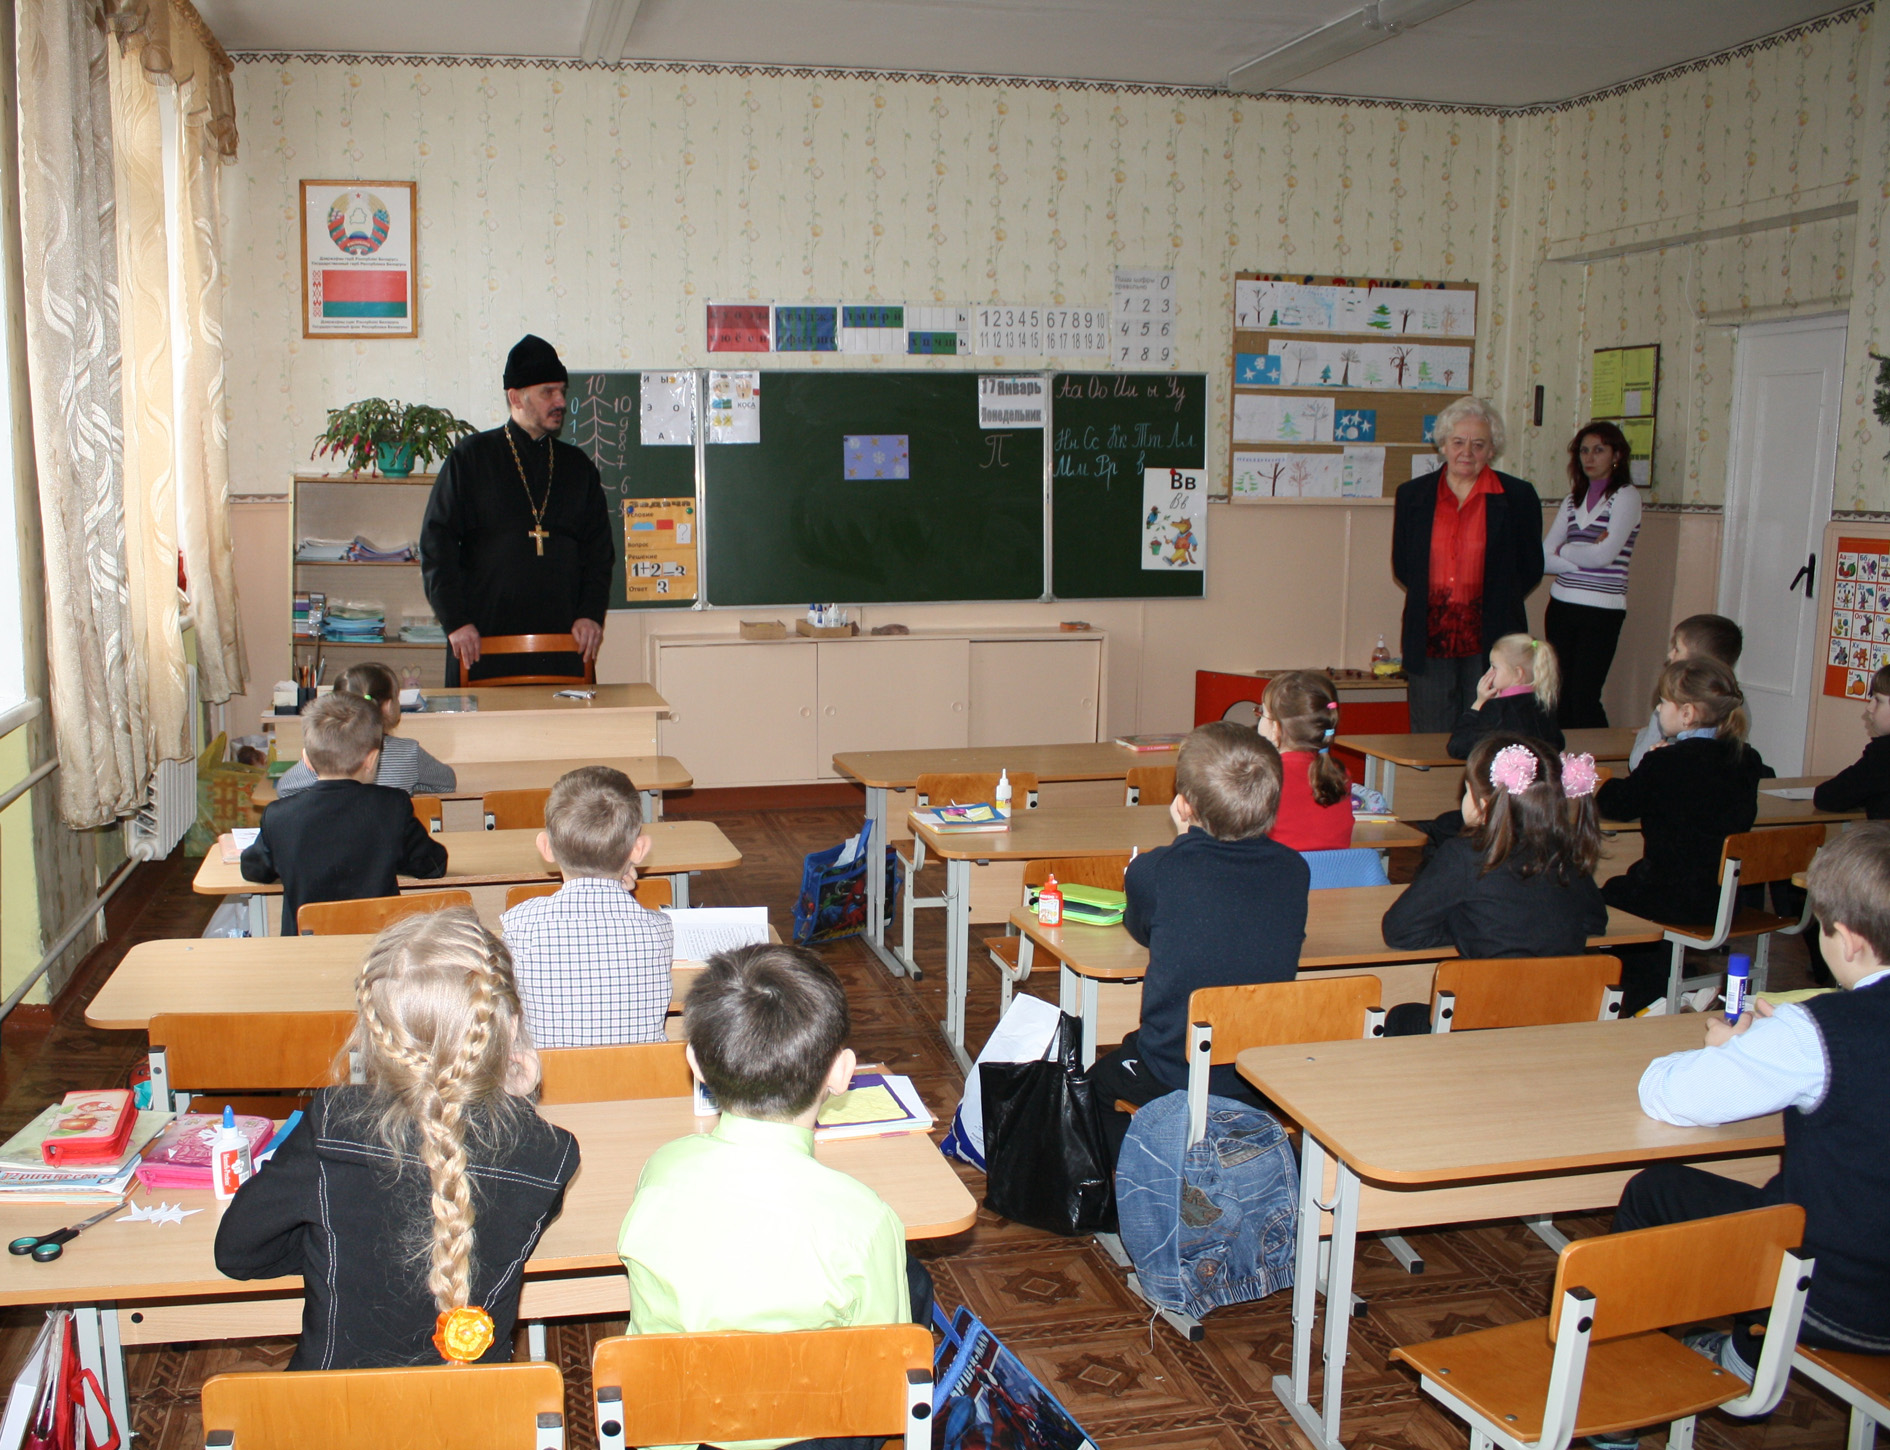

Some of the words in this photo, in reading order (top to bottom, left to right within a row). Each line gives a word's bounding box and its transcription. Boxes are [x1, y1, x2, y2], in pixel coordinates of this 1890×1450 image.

[1160, 275, 1170, 290] 0
[1123, 298, 1130, 312] 1
[1142, 298, 1150, 313] 2
[1161, 298, 1170, 313] 3
[980, 310, 988, 327] 1
[993, 310, 1001, 327] 2
[1006, 310, 1014, 327] 3
[1018, 311, 1026, 327] 4
[1030, 310, 1039, 327] 5
[1046, 312, 1055, 328] 6
[1059, 312, 1067, 328] 7
[1072, 312, 1080, 328] 8
[1084, 312, 1092, 328] 9
[1096, 312, 1105, 329] 10
[1121, 322, 1129, 336] 4
[1140, 322, 1150, 337] 5
[1161, 322, 1170, 337] 6
[980, 332, 989, 348] 11
[993, 332, 1001, 348] 12
[1006, 332, 1014, 348] 13
[1018, 332, 1026, 348] 14
[1030, 332, 1039, 348] 15
[1047, 333, 1055, 349] 16
[1059, 333, 1067, 349] 17
[1072, 333, 1080, 349] 18
[1084, 333, 1093, 349] 19
[1096, 333, 1105, 349] 20
[1121, 347, 1129, 361] 7
[1140, 347, 1150, 361] 8
[1161, 347, 1170, 361] 9
[585, 374, 606, 395] 10
[982, 378, 996, 394] 17
[570, 397, 579, 414] 0
[614, 395, 632, 413] 10
[569, 419, 577, 434] 1
[619, 416, 629, 433] 9
[618, 433, 627, 452] 8
[1054, 427, 1079, 451] Нн
[1083, 425, 1100, 450] Сс
[1107, 424, 1128, 449] Кк
[1166, 421, 1197, 449] Лл
[1053, 454, 1089, 477] Мм
[1094, 454, 1119, 491] Рр
[1170, 472, 1197, 490] Вв
[620, 476, 631, 494] 6
